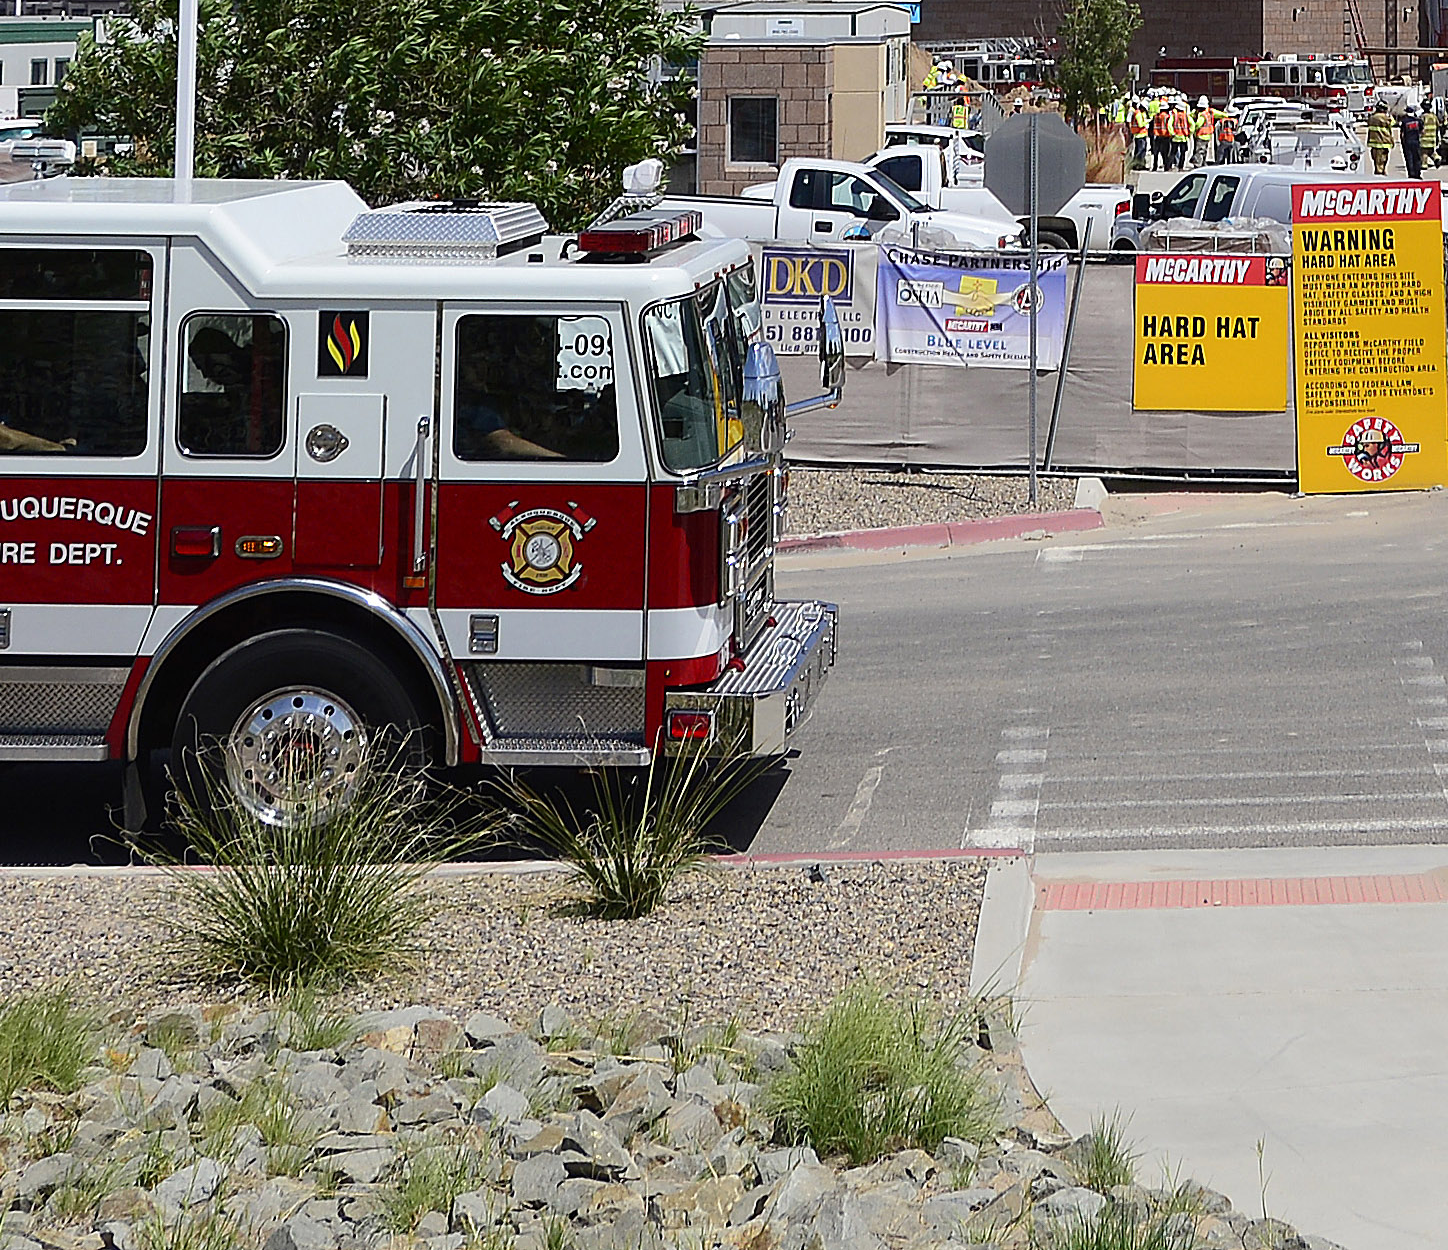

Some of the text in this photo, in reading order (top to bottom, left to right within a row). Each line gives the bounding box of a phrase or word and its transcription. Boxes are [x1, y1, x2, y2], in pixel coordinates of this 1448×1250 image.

[1302, 229, 1394, 251] WARNING
[888, 249, 1062, 272] CHASE PARTNERSHIP
[1302, 253, 1396, 268] HARD HAT AREA
[766, 257, 847, 296] DKD
[1302, 272, 1415, 282] EVERYONE ENTERING THIS SITE
[1326, 282, 1346, 290] WEAR
[1361, 281, 1399, 289] APPROVED
[1401, 280, 1421, 288] HARD
[1323, 290, 1349, 299] SAFETY
[1390, 289, 1404, 297] AND
[1414, 288, 1432, 296] HIGH
[1303, 297, 1418, 308] VISIBILITY GARMENT AND MUST
[843, 312, 861, 322] LLC
[1303, 309, 1325, 317] ABIDE
[1327, 308, 1337, 316] BY
[1339, 308, 1352, 316] ALL
[1355, 307, 1382, 315] SAFETY
[1401, 306, 1429, 314] HEALTH
[1143, 315, 1260, 338] HARD HAT
[1303, 317, 1347, 326] STANDARDS
[1304, 331, 1360, 340] ALL VISITORS
[927, 335, 1007, 350] BLUE LEVEL
[1304, 340, 1332, 349] REPORT
[1335, 340, 1344, 348] TO
[1347, 339, 1360, 348] THE
[1404, 338, 1424, 346] FIELD
[1143, 343, 1206, 365] AREA
[1304, 349, 1329, 358] OFFICE
[1332, 349, 1341, 357] TO
[1344, 348, 1373, 357] RECEIVE
[1376, 348, 1389, 356] THE
[1304, 358, 1331, 367] SAFETY
[1334, 358, 1375, 366] EQUIPMENT
[1304, 367, 1340, 376] ENTERING
[1343, 367, 1356, 375] THE
[1359, 366, 1415, 374] CONSTRUCTION
[1305, 381, 1348, 390] ACCORDING
[1351, 381, 1359, 389] TO
[1362, 380, 1394, 388] FEDERAL
[1305, 388, 1434, 399] SAFETY ON THE JOB IS EVERYONE'S
[1305, 399, 1369, 408] RESPONSIBILITY!
[1345, 418, 1400, 445] SAFETY
[1348, 456, 1401, 481] WORKS
[50, 543, 122, 565] DEPT.
